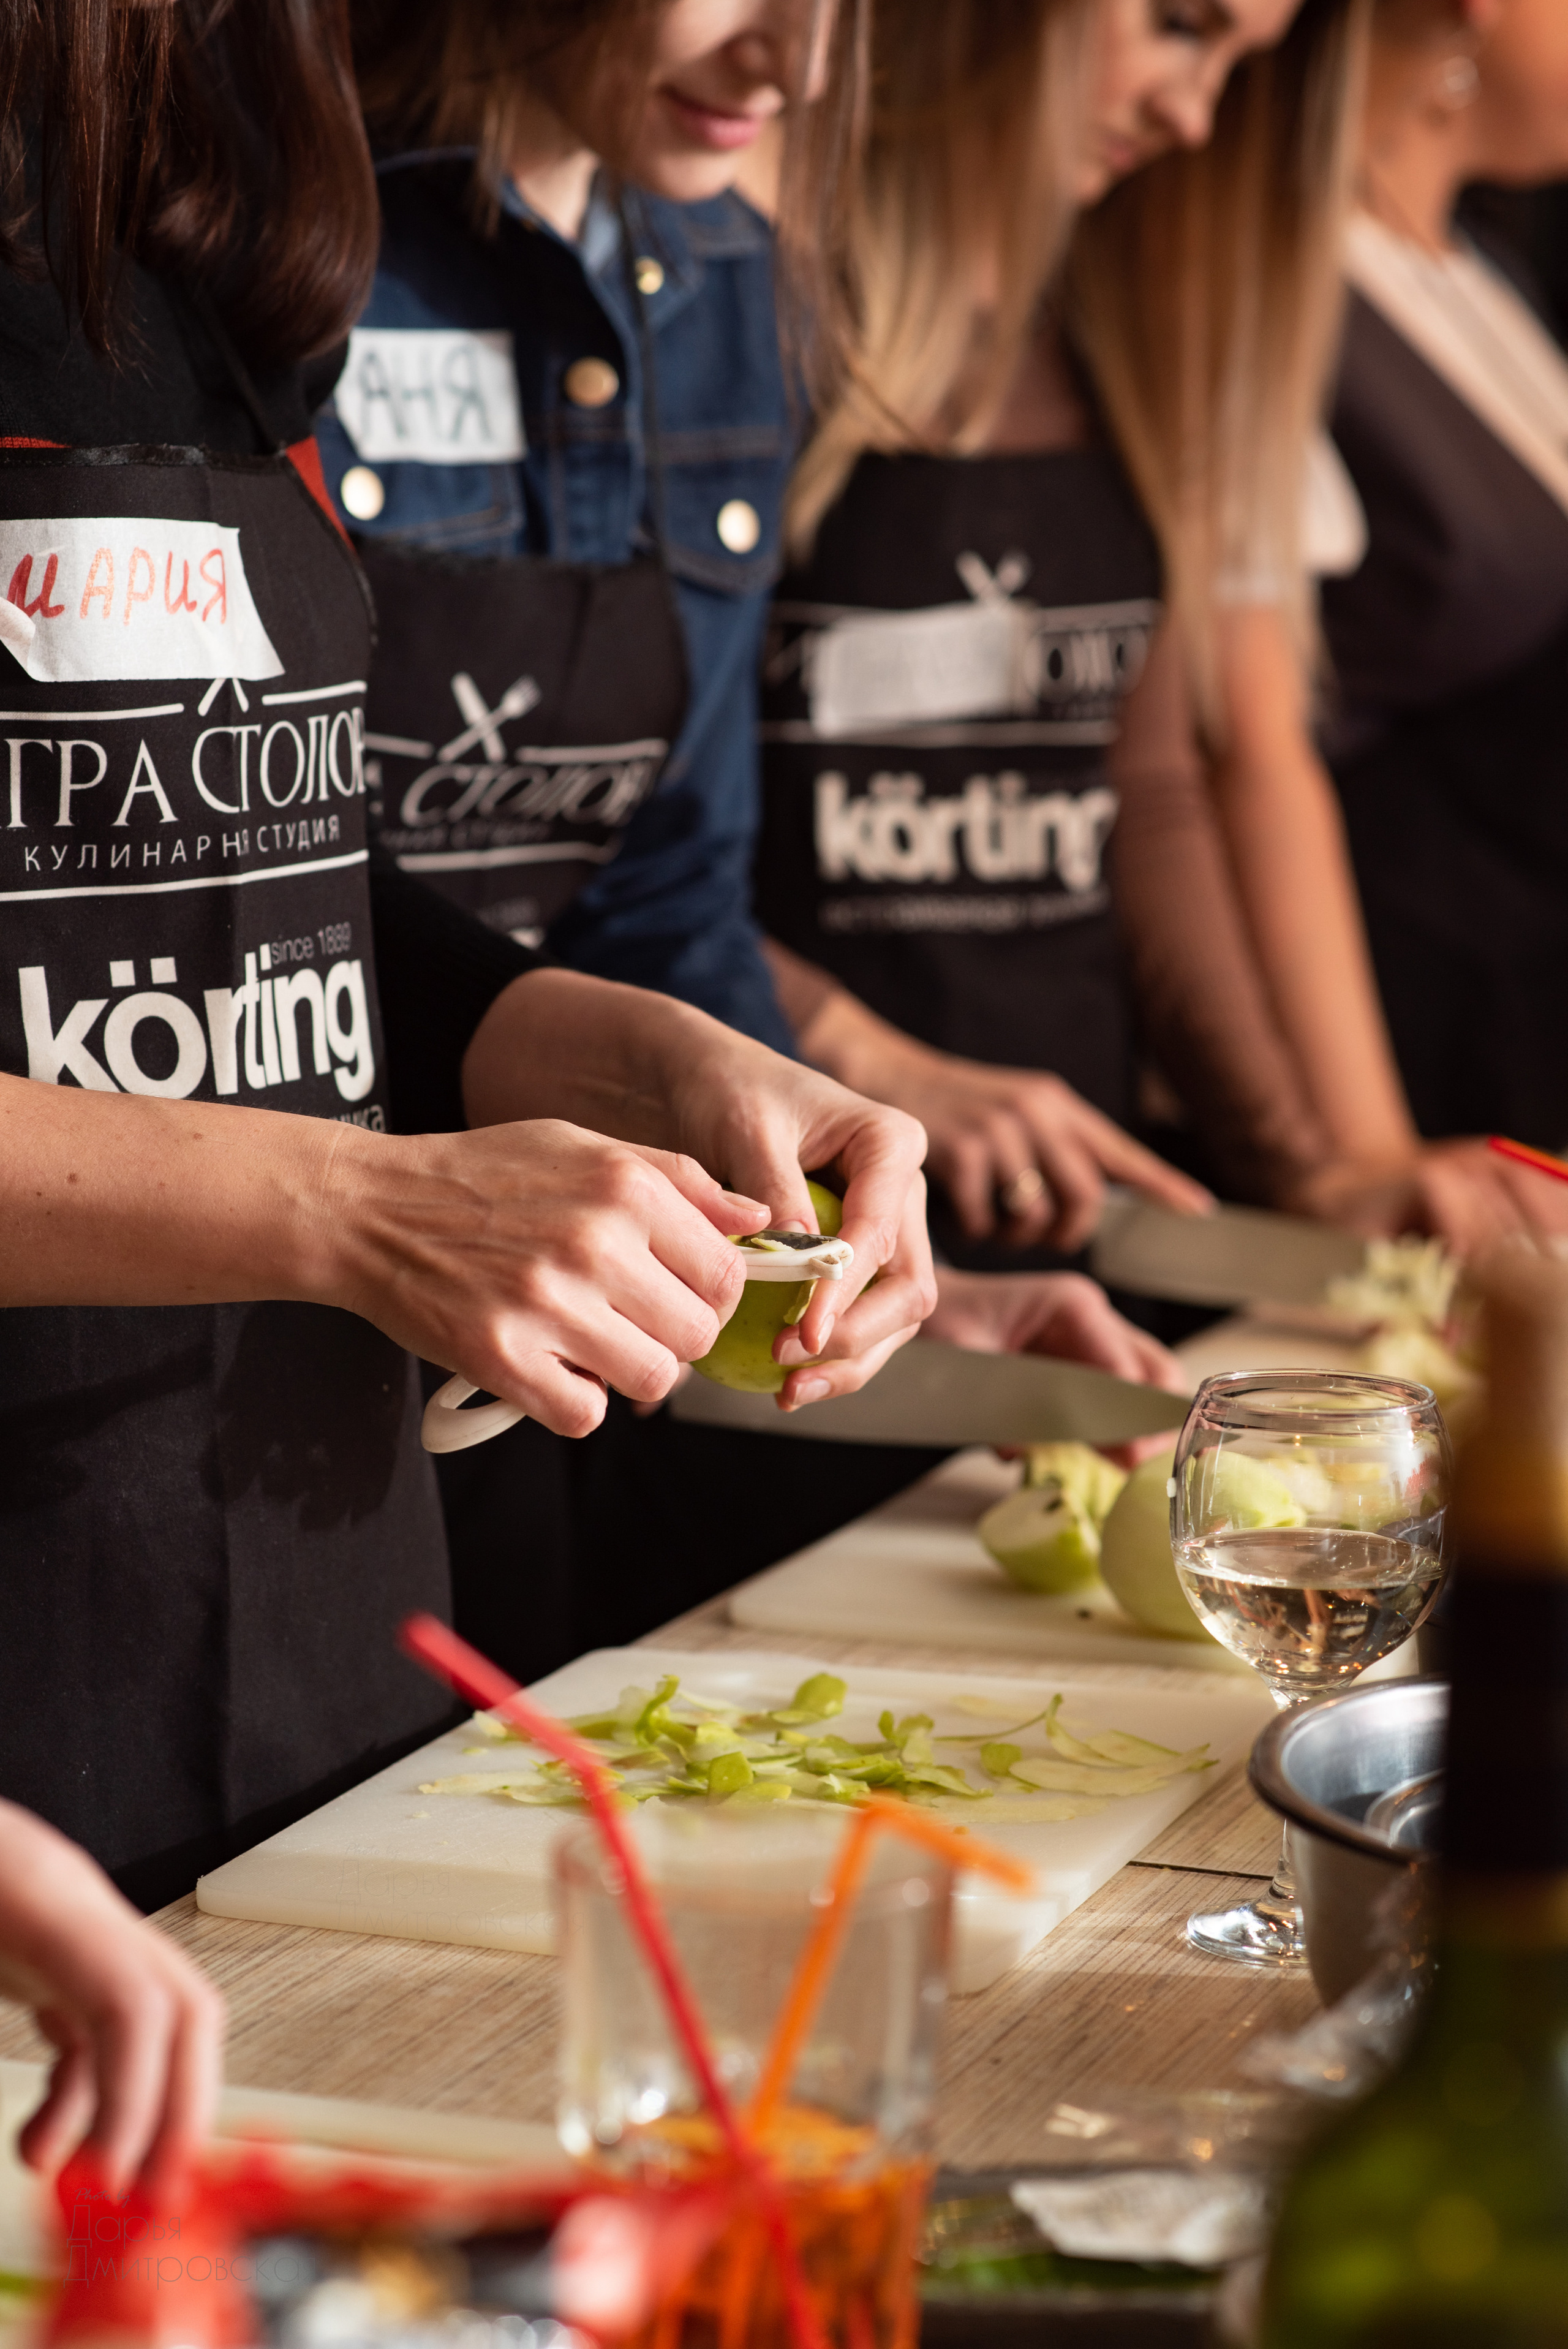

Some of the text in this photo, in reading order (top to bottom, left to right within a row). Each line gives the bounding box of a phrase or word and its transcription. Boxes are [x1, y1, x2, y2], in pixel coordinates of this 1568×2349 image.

[356, 344, 495, 444] АНЯ
[0, 738, 179, 828] ГРА
[257, 814, 340, 852] СТУДИЯ
[271, 934, 314, 965] since
[18, 944, 375, 1102] körting
